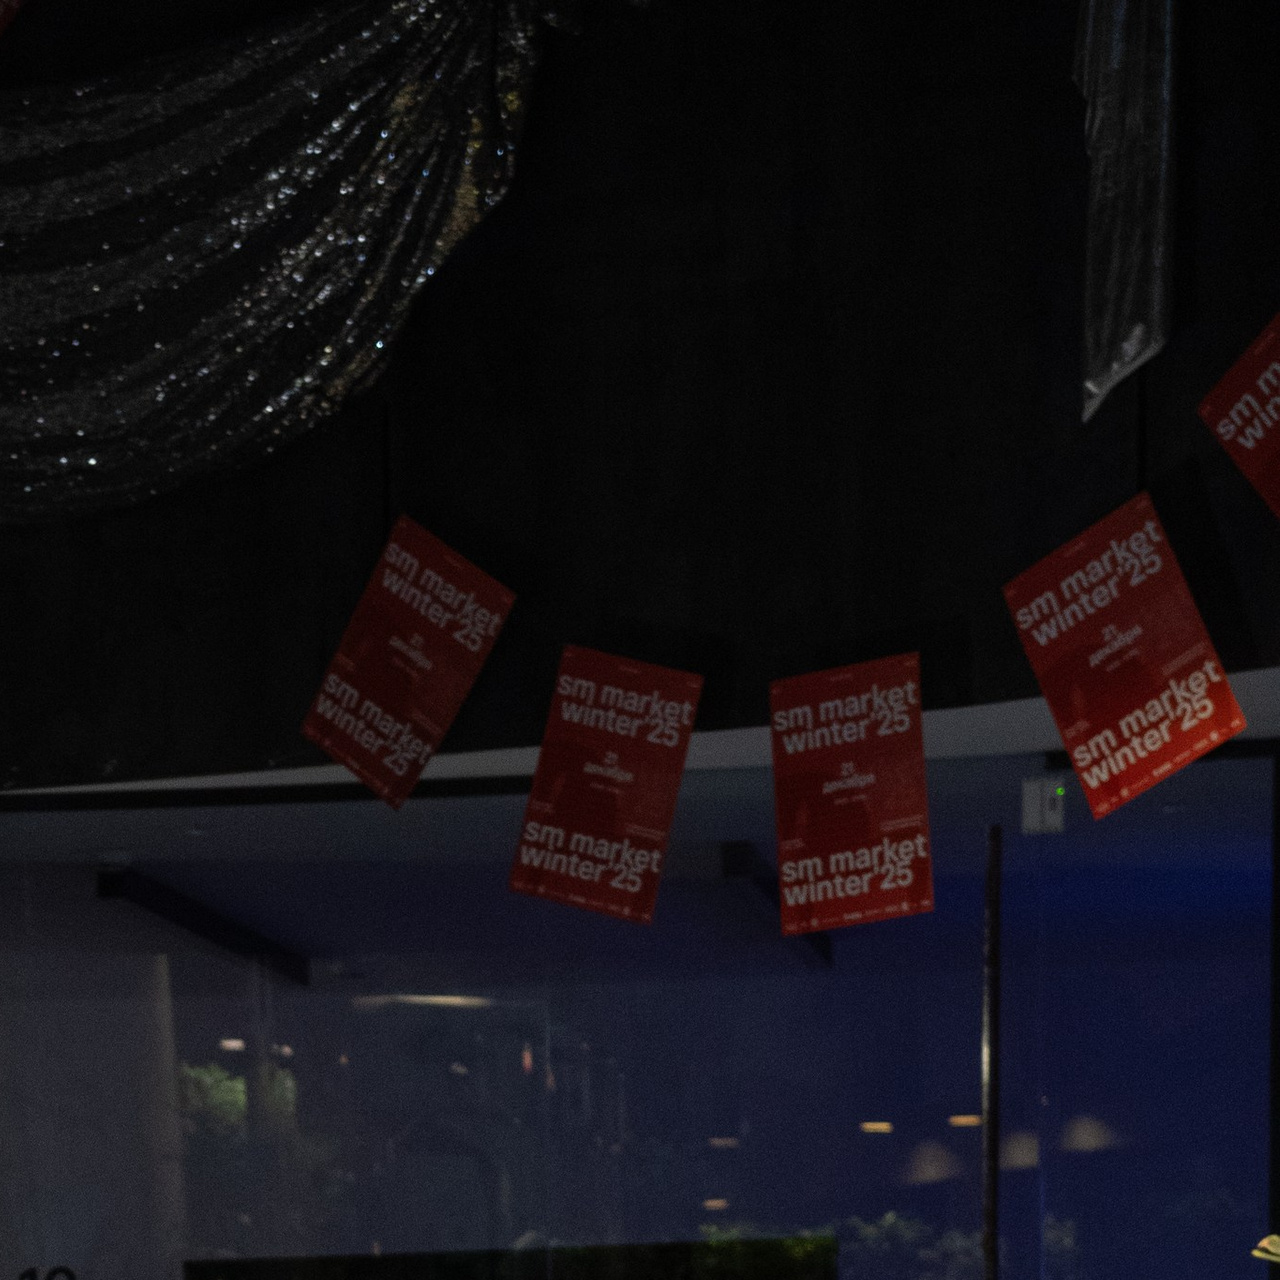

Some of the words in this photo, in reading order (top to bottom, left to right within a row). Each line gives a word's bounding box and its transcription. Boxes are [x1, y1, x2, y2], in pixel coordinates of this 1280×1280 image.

[1217, 393, 1263, 441] sm
[384, 542, 420, 579] sm
[420, 568, 502, 637] market
[1015, 590, 1060, 630] sm
[1060, 520, 1162, 598] market
[323, 673, 359, 709] sm
[360, 697, 432, 765] market
[558, 674, 596, 706] sm
[601, 685, 693, 725] market
[773, 704, 813, 733] sm
[819, 681, 918, 724] market
[1073, 728, 1118, 768] sm
[1119, 660, 1221, 739] market
[524, 821, 564, 850] sm
[570, 832, 663, 873] market
[781, 856, 823, 883] sm
[829, 833, 928, 874] market
